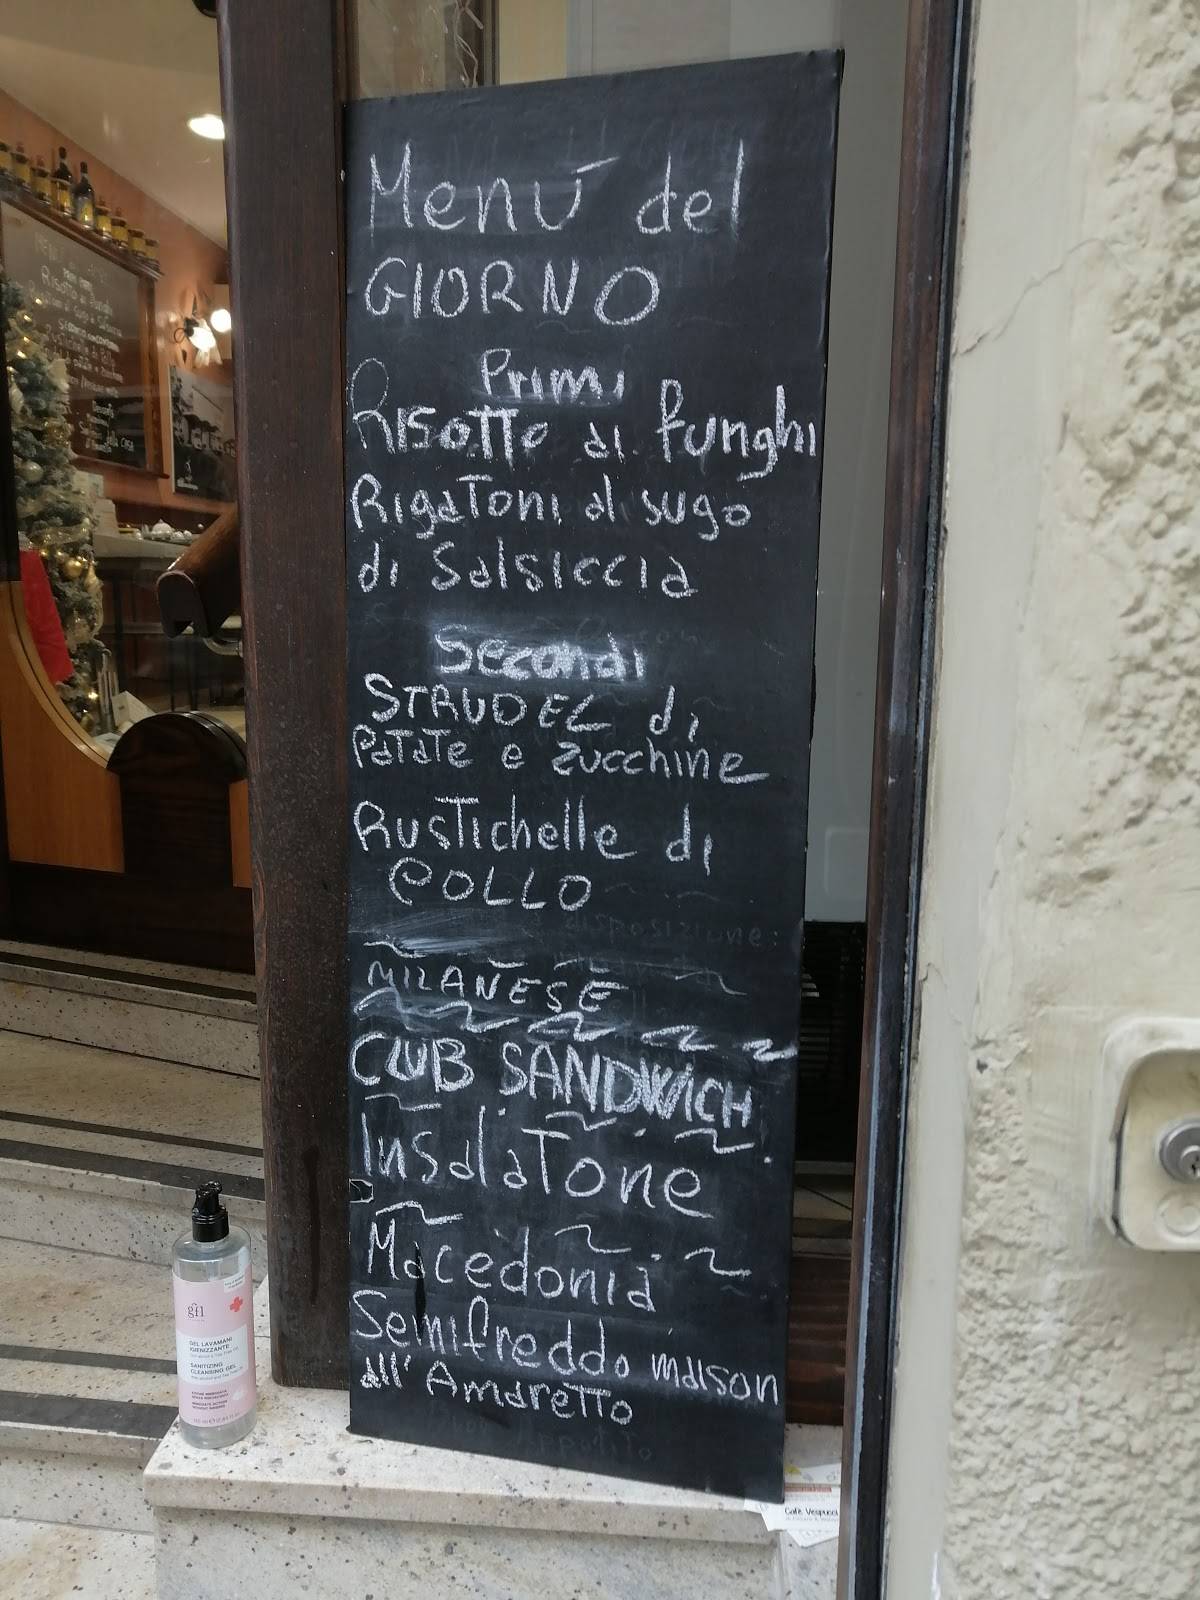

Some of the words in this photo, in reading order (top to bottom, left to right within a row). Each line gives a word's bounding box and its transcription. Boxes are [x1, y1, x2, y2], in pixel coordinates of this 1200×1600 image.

[636, 138, 744, 238] del
[364, 256, 660, 325] GIORNO
[481, 348, 625, 404] Primi
[656, 378, 817, 482] funghi
[585, 473, 616, 522] al
[641, 489, 752, 541] sugo
[358, 542, 398, 592] di
[431, 537, 698, 599] Salsiccia
[434, 624, 647, 681] Secondi
[363, 673, 612, 732] STRUDEL
[649, 685, 699, 742] di
[502, 743, 524, 769] e
[666, 803, 712, 876] di
[366, 961, 629, 1013] MILANESE
[499, 1042, 752, 1128] SANDWICH
[368, 1218, 655, 1312] Macedonia
[352, 1289, 630, 1377] Semifreddo
[652, 1353, 779, 1405] maison
